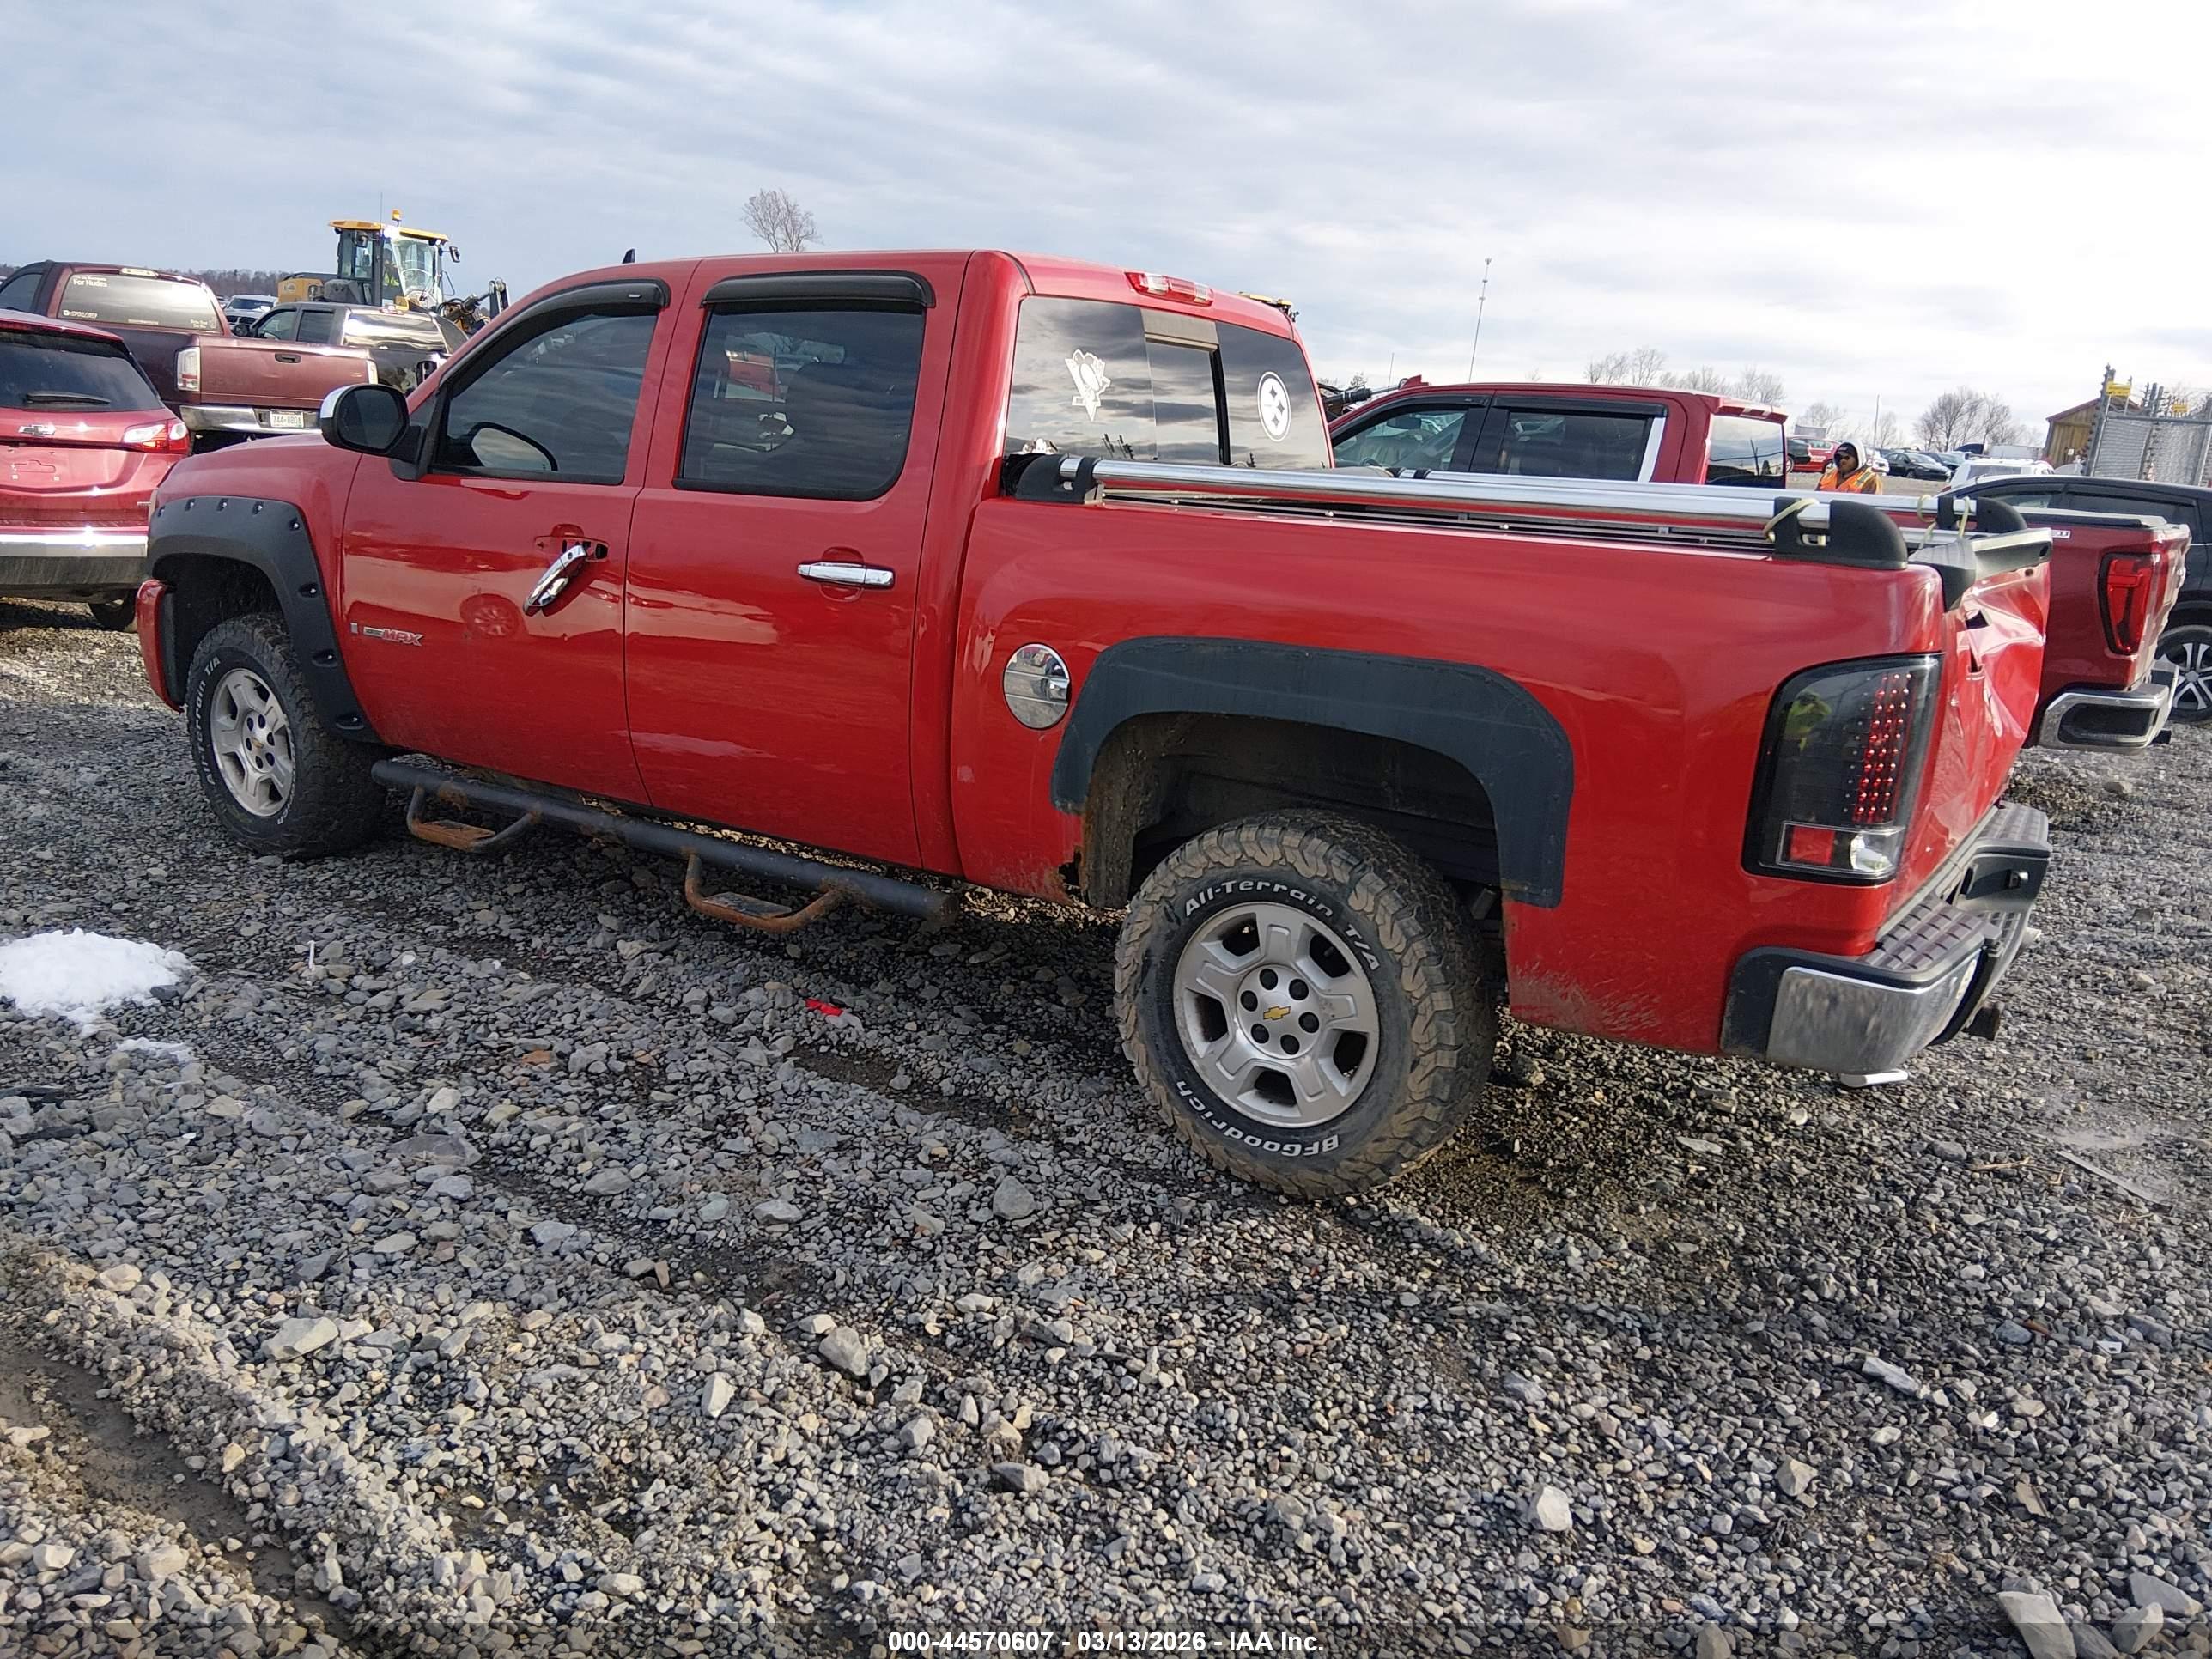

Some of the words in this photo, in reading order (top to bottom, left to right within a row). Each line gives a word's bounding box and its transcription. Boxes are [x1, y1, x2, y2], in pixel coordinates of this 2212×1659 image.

[204, 656, 221, 676] T/A
[1184, 880, 1334, 917] All-Terrain
[1345, 923, 1381, 970] T/A
[1176, 1080, 1340, 1157] BFGoodrich
